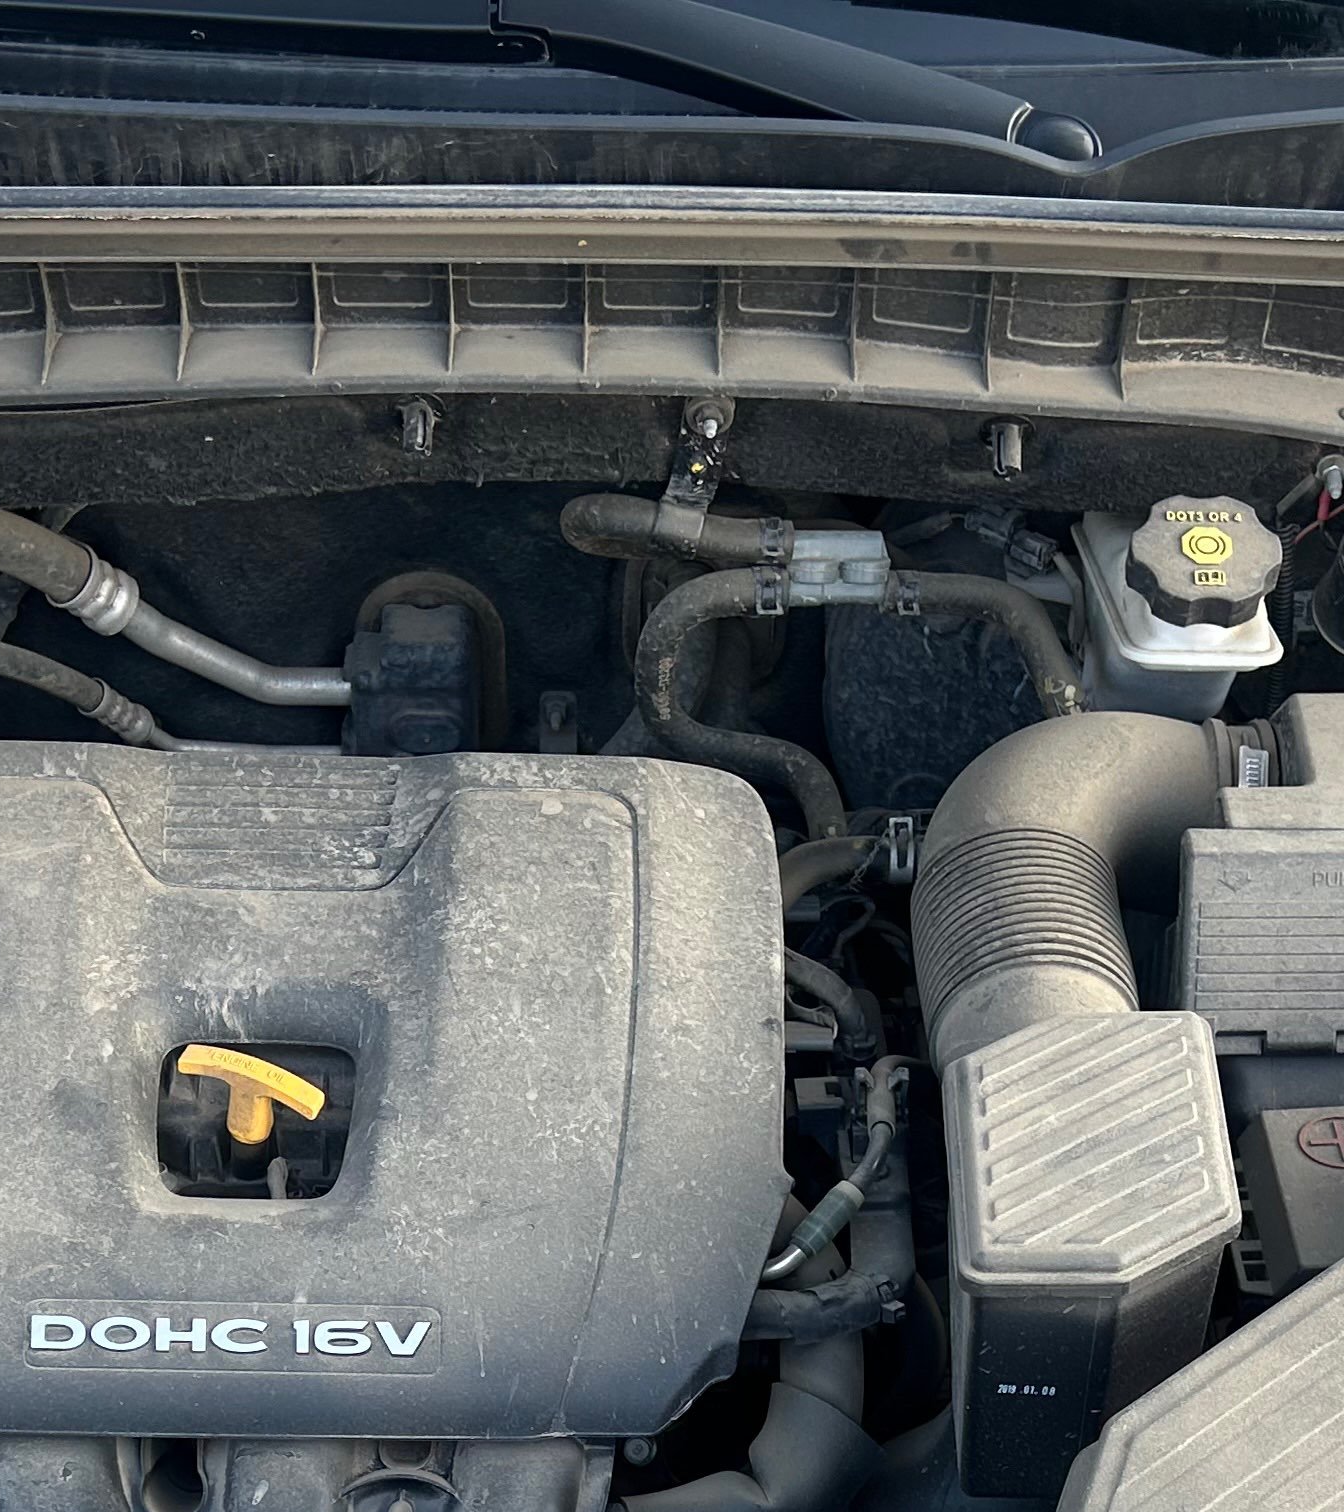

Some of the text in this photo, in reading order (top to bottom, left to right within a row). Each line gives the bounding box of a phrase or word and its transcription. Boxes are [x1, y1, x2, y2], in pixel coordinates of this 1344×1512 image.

[1165, 510, 1244, 523] DOT3 OR 4
[29, 1314, 433, 1358] DOHC 16V
